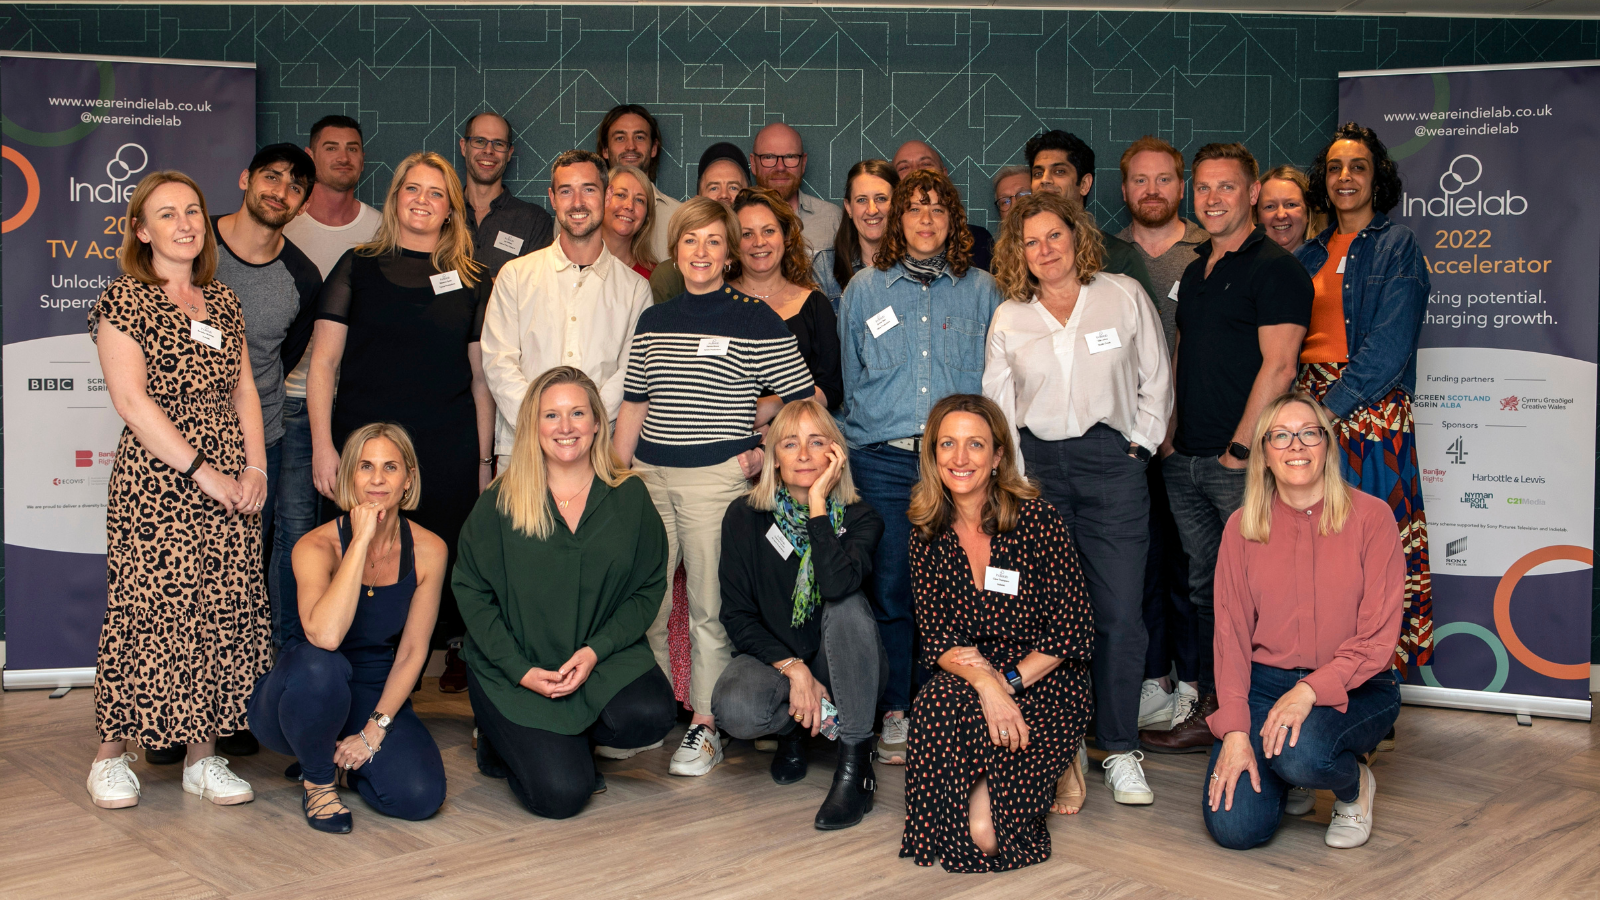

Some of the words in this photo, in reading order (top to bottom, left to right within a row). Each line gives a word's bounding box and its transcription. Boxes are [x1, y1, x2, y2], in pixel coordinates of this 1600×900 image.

[49, 97, 212, 112] www.weareindielab.co.uk
[81, 112, 182, 127] @weareindielab
[1383, 104, 1553, 122] www.weareindielab.co.uk
[1414, 122, 1519, 137] @weareindielab
[70, 177, 137, 203] Indie
[1402, 190, 1528, 217] Indielab
[103, 216, 127, 234] 20
[1435, 229, 1492, 249] 2022
[46, 239, 78, 258] TV
[51, 274, 114, 289] Unlocki
[1428, 290, 1461, 308] king
[1467, 290, 1547, 308] potential.
[1423, 310, 1487, 329] harging
[1493, 310, 1558, 329] growth.
[29, 379, 73, 390] BBC
[1426, 375, 1459, 384] Funding
[1461, 376, 1495, 384] partners
[1442, 420, 1479, 430] Sponsors
[1472, 473, 1513, 483] Harbottle
[1520, 475, 1546, 484] Lewis
